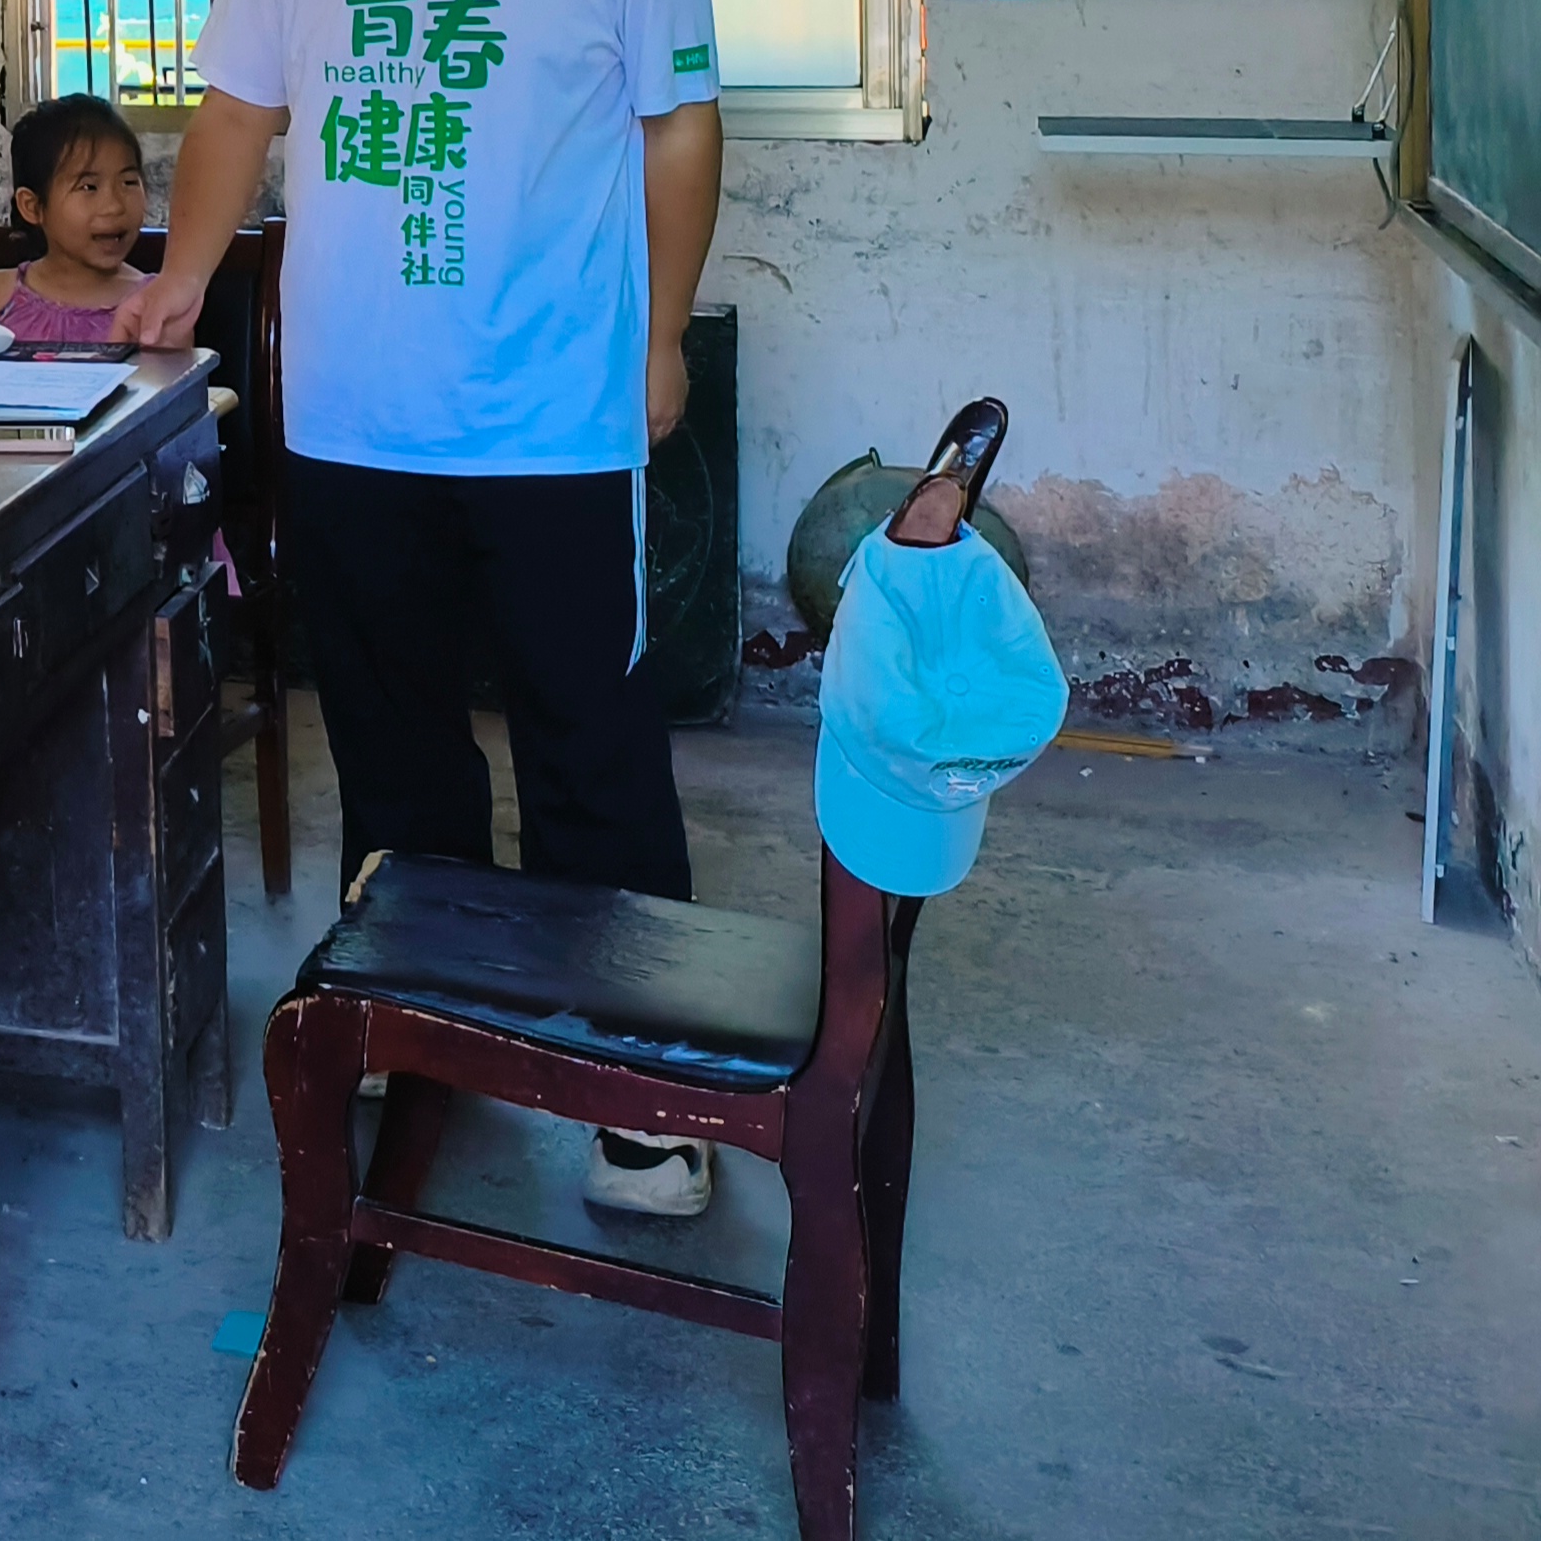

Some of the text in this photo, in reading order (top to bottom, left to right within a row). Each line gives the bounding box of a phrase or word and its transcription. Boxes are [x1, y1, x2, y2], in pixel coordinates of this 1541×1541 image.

[324, 61, 426, 90] healthy
[319, 90, 473, 188] 健康
[400, 175, 437, 287] 同伴社
[438, 178, 467, 288] young
